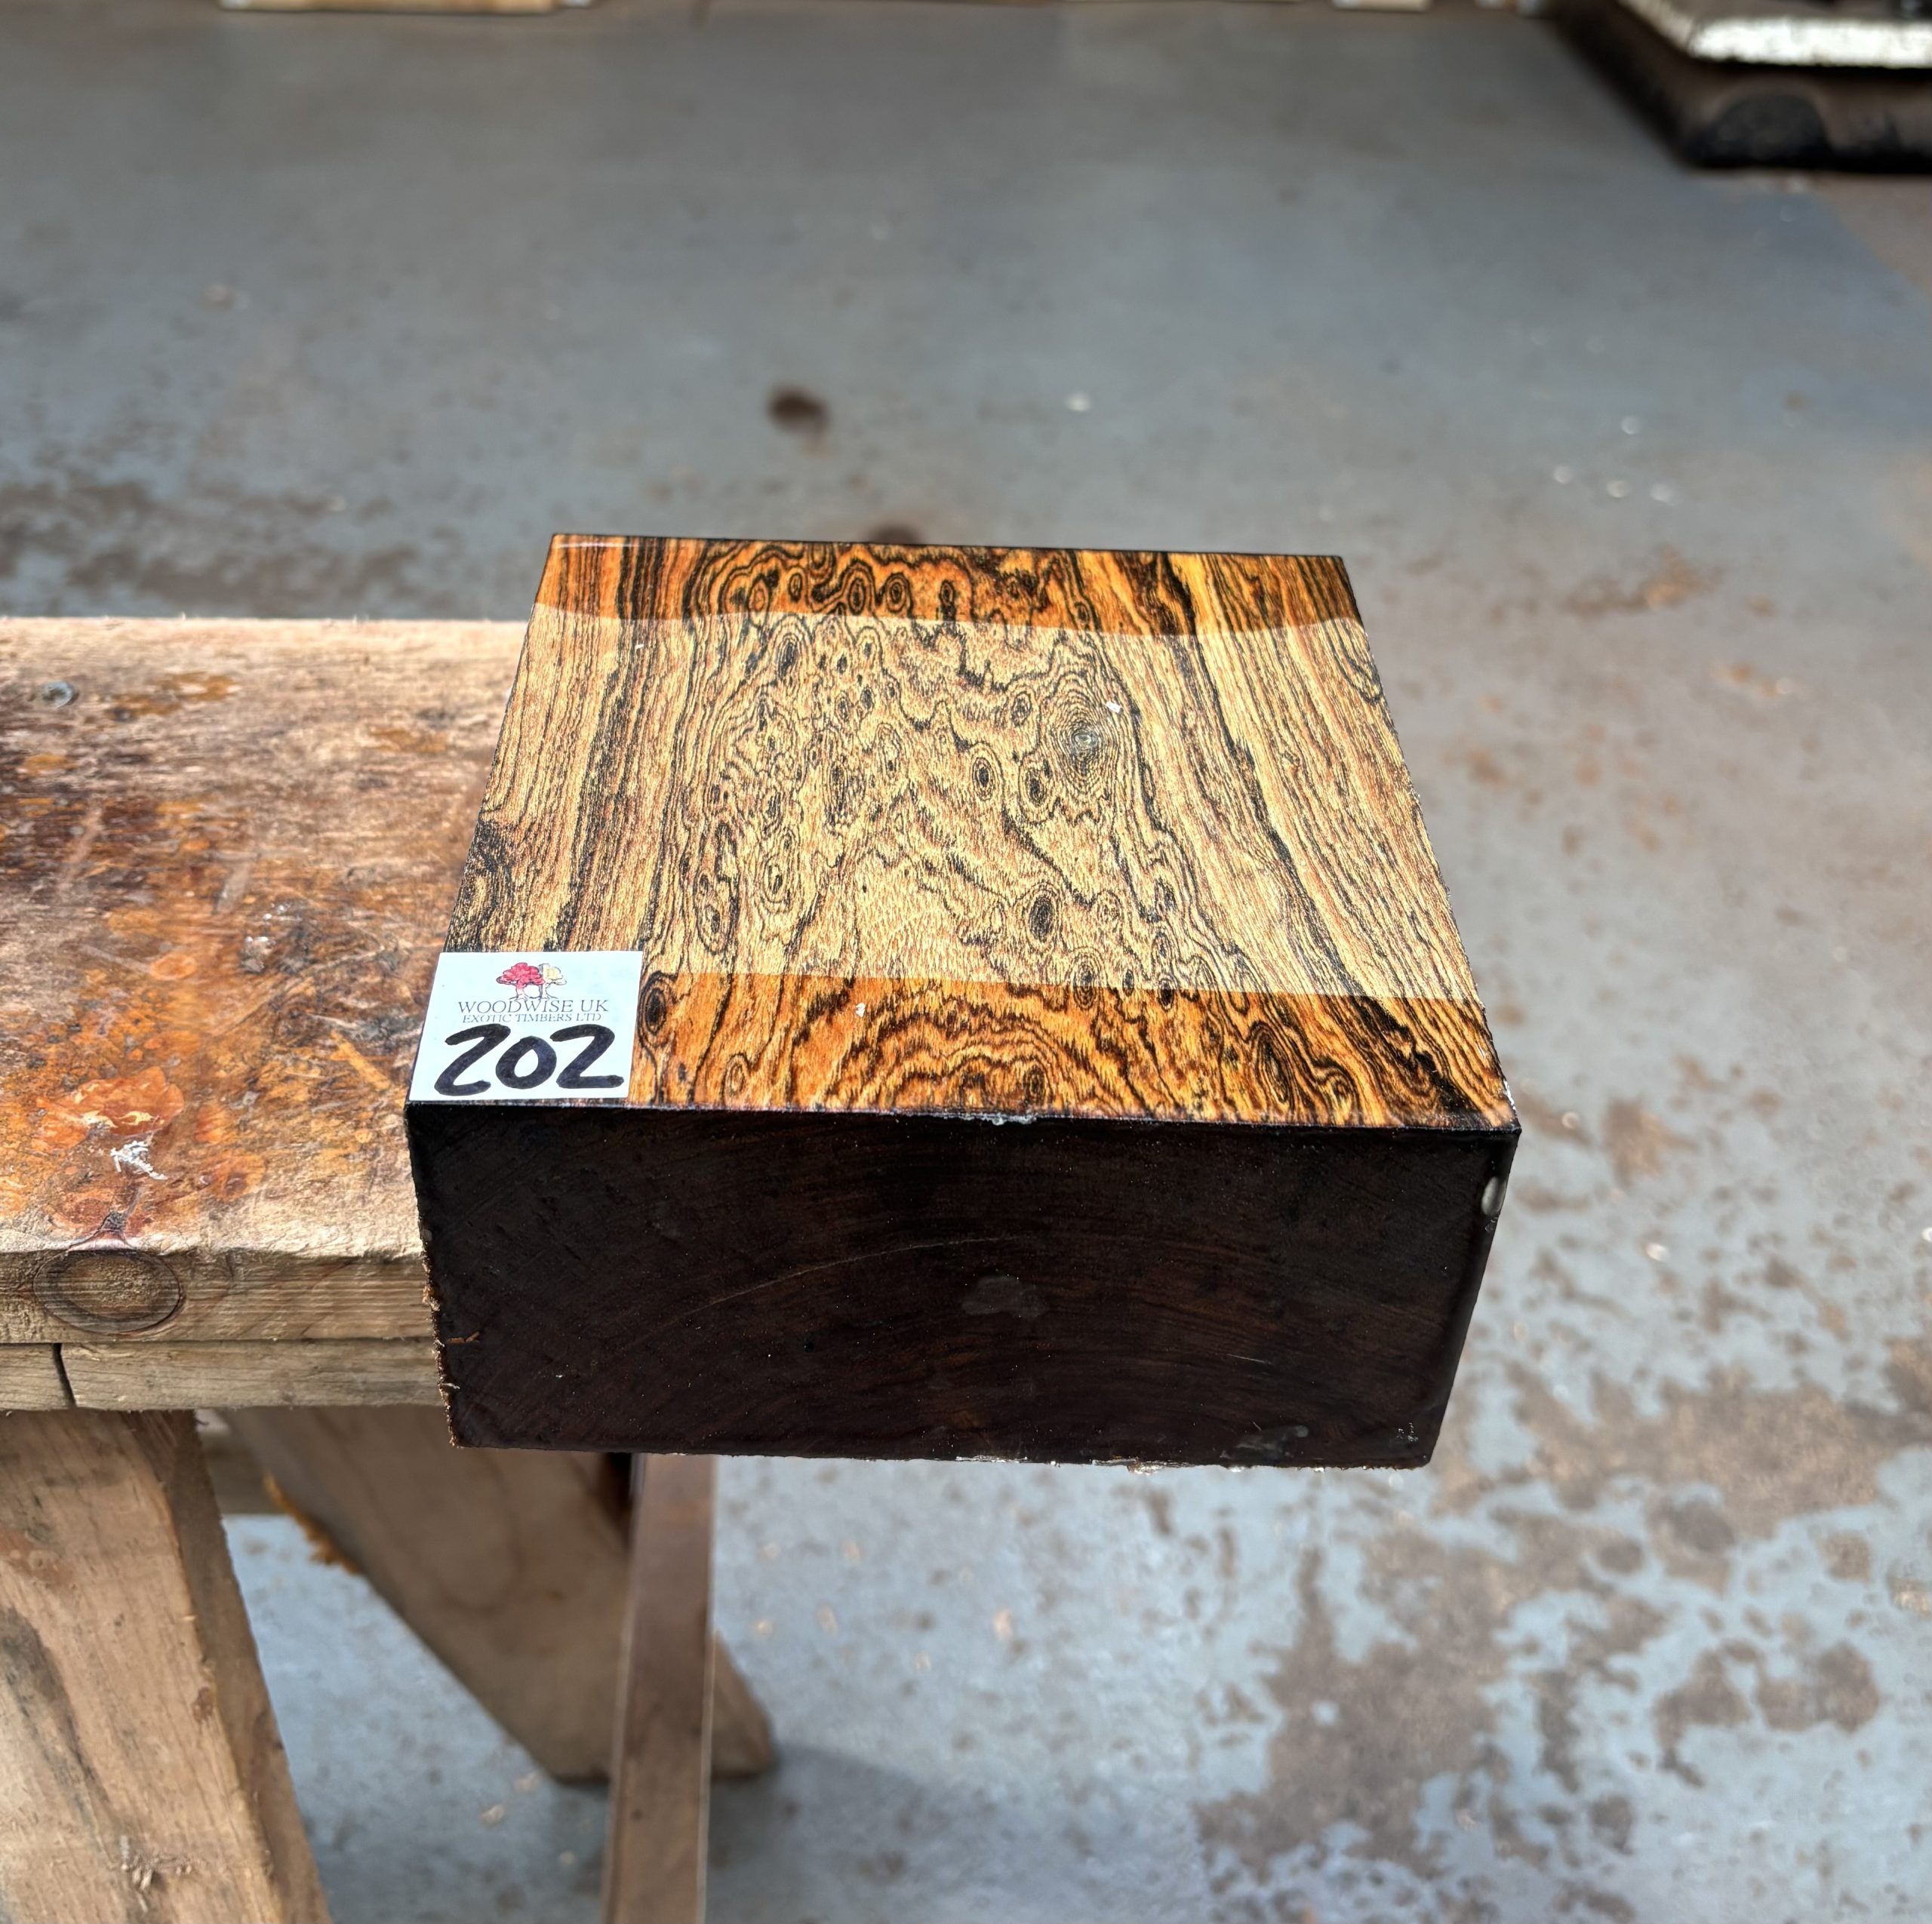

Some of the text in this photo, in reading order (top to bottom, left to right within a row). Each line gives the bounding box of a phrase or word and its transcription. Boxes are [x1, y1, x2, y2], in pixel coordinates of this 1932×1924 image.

[457, 1000, 609, 1013] WOODWISE UK
[462, 1013, 601, 1023] EXOTIC TIMBERS LTD
[434, 1023, 624, 1096] 202
